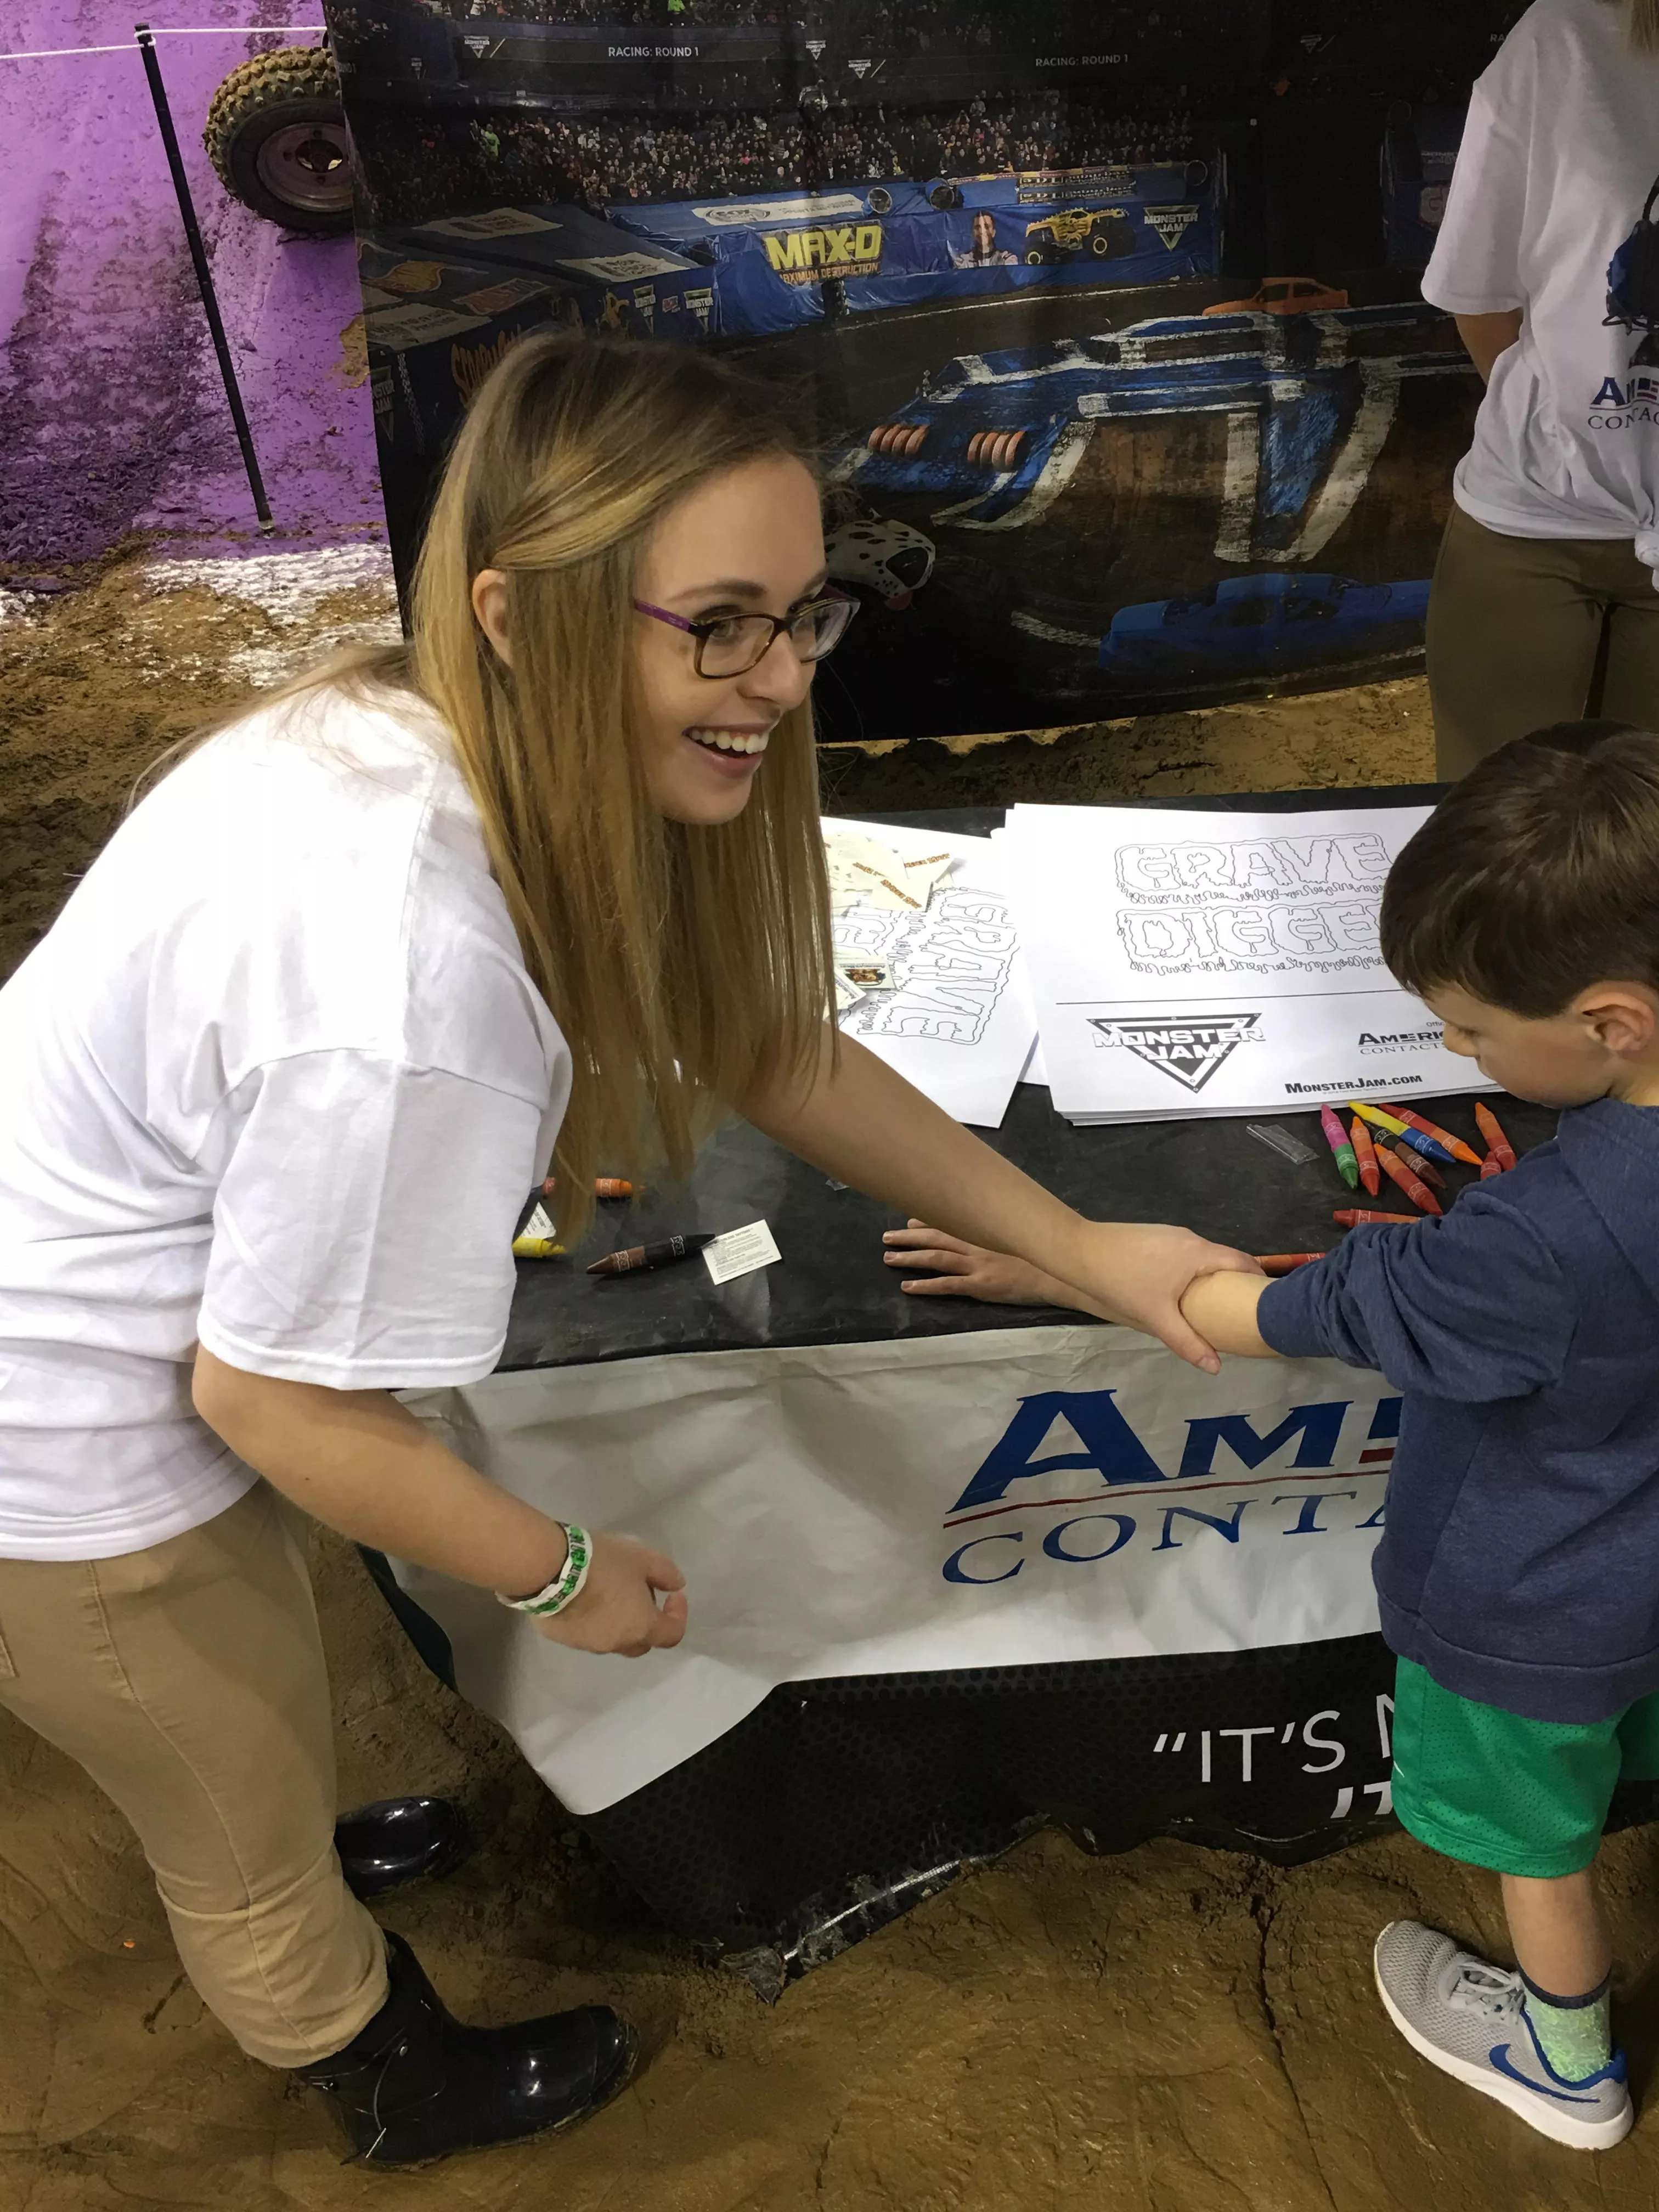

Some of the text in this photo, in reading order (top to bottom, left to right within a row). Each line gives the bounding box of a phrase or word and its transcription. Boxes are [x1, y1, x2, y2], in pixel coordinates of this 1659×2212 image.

[608, 46, 699, 57] RACING: ROUND 1
[1035, 57, 1079, 67] RACING:
[1082, 55, 1121, 65] ROUND
[1144, 213, 1198, 224] MONSTER
[1159, 223, 1183, 233] JAM
[765, 225, 882, 270] MAX-D
[821, 262, 878, 279] DESTRUCTION
[1115, 833, 1393, 898] GRAVE
[1117, 900, 1384, 964] DIGGE
[1092, 1025, 1266, 1048] MONSTER
[1144, 1042, 1224, 1061] JAM
[943, 1491, 1387, 1585] CONT
